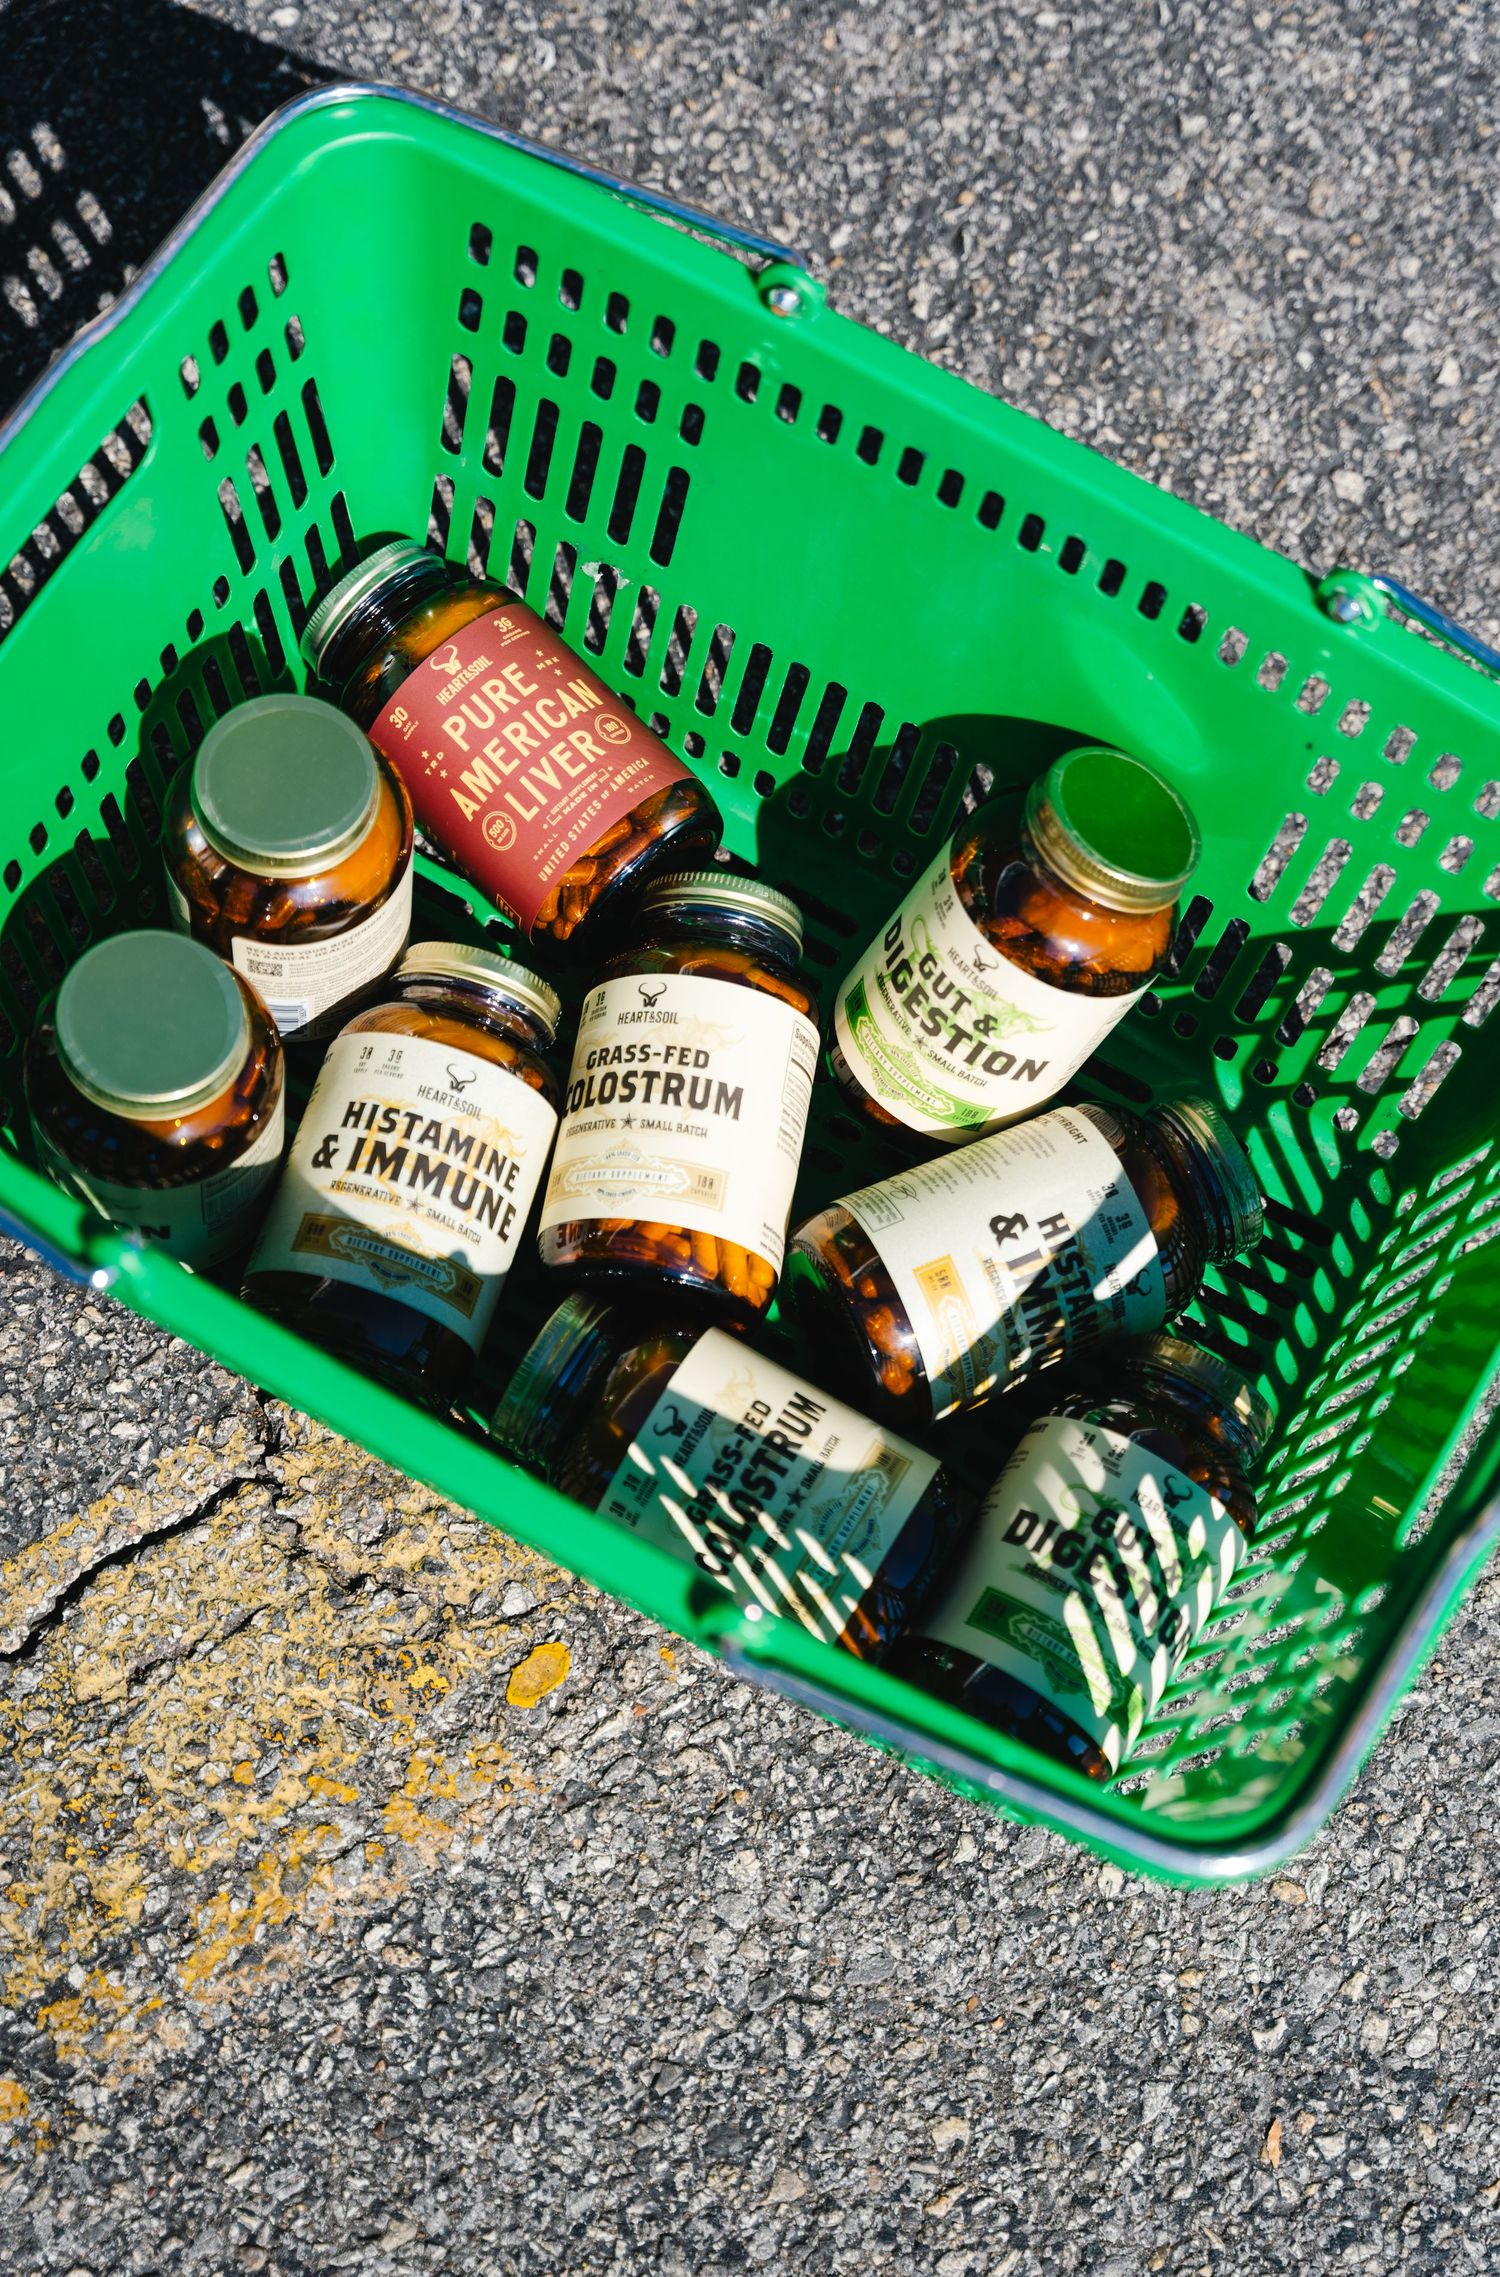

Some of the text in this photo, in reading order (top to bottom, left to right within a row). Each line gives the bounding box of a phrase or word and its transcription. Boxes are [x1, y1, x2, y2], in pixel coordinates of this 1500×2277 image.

[494, 617, 515, 632] 3G
[435, 655, 494, 706] HEART&SOIL
[536, 656, 560, 671] MRK
[389, 706, 409, 729] 30
[441, 661, 539, 752] PURE
[403, 720, 412, 733] DAY
[403, 720, 420, 741] SUPPLY
[602, 720, 619, 733] 180
[424, 751, 445, 777] TRD
[450, 678, 604, 823] AMERICAN
[503, 729, 607, 823] LIVER
[567, 771, 599, 799] SUPPLEMENT
[627, 774, 655, 793] BATCH
[561, 781, 599, 815] MADE IN
[488, 819, 505, 839] 500
[538, 841, 570, 882] UNITED
[567, 799, 602, 841] STATES
[600, 788, 611, 800] OF
[611, 757, 650, 792] AMERICA
[533, 833, 559, 861] SMALL
[947, 946, 999, 1001] HEART&SOIL
[884, 913, 1050, 1083] DIGESTION
[918, 952, 972, 1015] GUT
[973, 1013, 998, 1038] &
[617, 1010, 680, 1026] HEART&SOIL
[876, 971, 913, 1037] REGENERATIVE
[926, 1048, 956, 1075] SMALL
[957, 1069, 988, 1088] BATCH
[586, 1044, 711, 1071] GRASS-FED
[416, 1084, 482, 1121] HEART&SOIL
[562, 1070, 745, 1122] COLOSTRUM
[340, 1100, 521, 1194] HISTAMINE
[639, 1118, 673, 1132] SMALL
[675, 1122, 709, 1140] BATCH
[311, 1133, 517, 1243] & IMMUNE
[575, 1170, 607, 1182] DIETARY
[610, 1170, 670, 1182] SUPPLEMENT
[328, 1179, 483, 1246] REGENERATIVE SMALL BATCH
[989, 1212, 1029, 1248] &
[387, 1247, 443, 1280] SUPPLEMENT
[685, 1400, 772, 1525] GRASS-FED
[800, 1459, 825, 1490] SMALL
[820, 1434, 841, 1459] BATCH
[694, 1391, 827, 1576] COLOSTRUM
[1091, 1507, 1185, 1593] GUT &
[1001, 1508, 1193, 1667] DIGESTION
